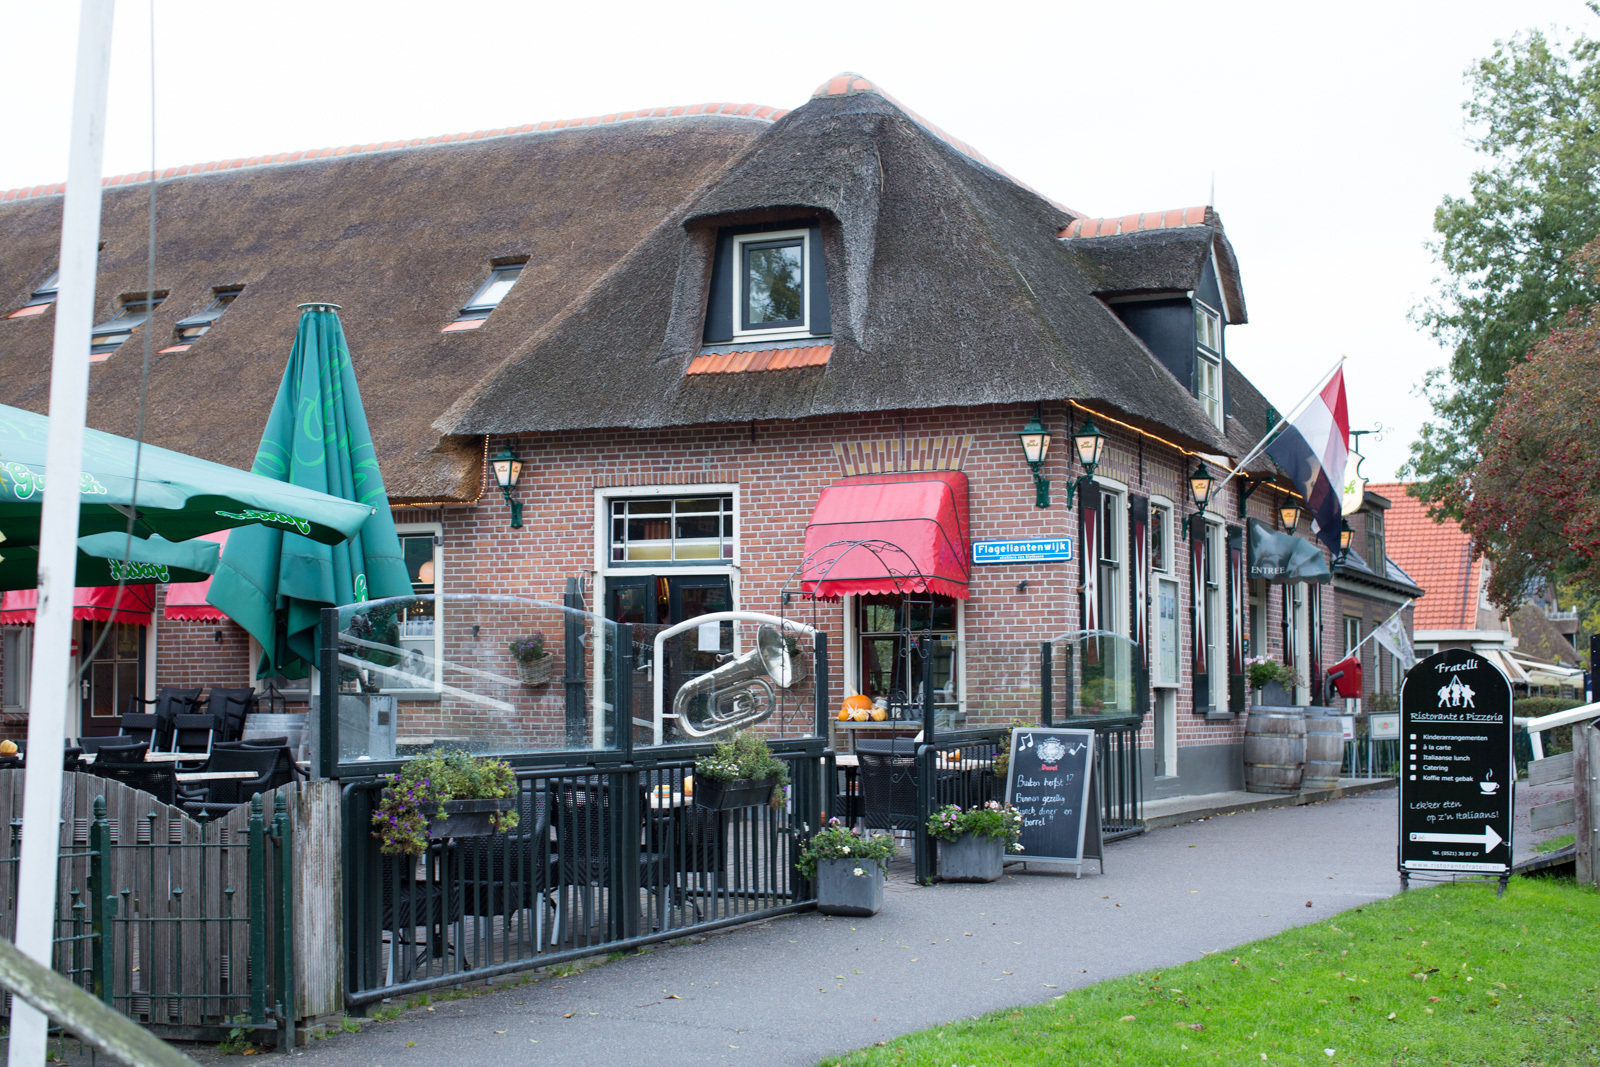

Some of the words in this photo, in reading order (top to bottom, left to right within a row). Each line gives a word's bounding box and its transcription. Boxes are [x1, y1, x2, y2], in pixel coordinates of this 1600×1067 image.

[978, 542, 1066, 555] Flagellantenwijk
[1434, 659, 1478, 673] Fratelli
[1410, 712, 1458, 720] Ristorante
[1466, 712, 1503, 721] Pizzeria
[1017, 774, 1040, 787] Buiten
[1043, 777, 1063, 789] herfst
[1015, 792, 1039, 802] Binnen
[1042, 794, 1065, 805] gezellig
[1410, 801, 1441, 809] Lekker
[1443, 801, 1462, 809] eten
[1039, 807, 1058, 815] diner
[1426, 815, 1436, 824] op
[1456, 811, 1499, 820] Italiaans!
[1024, 817, 1046, 827] borrel
